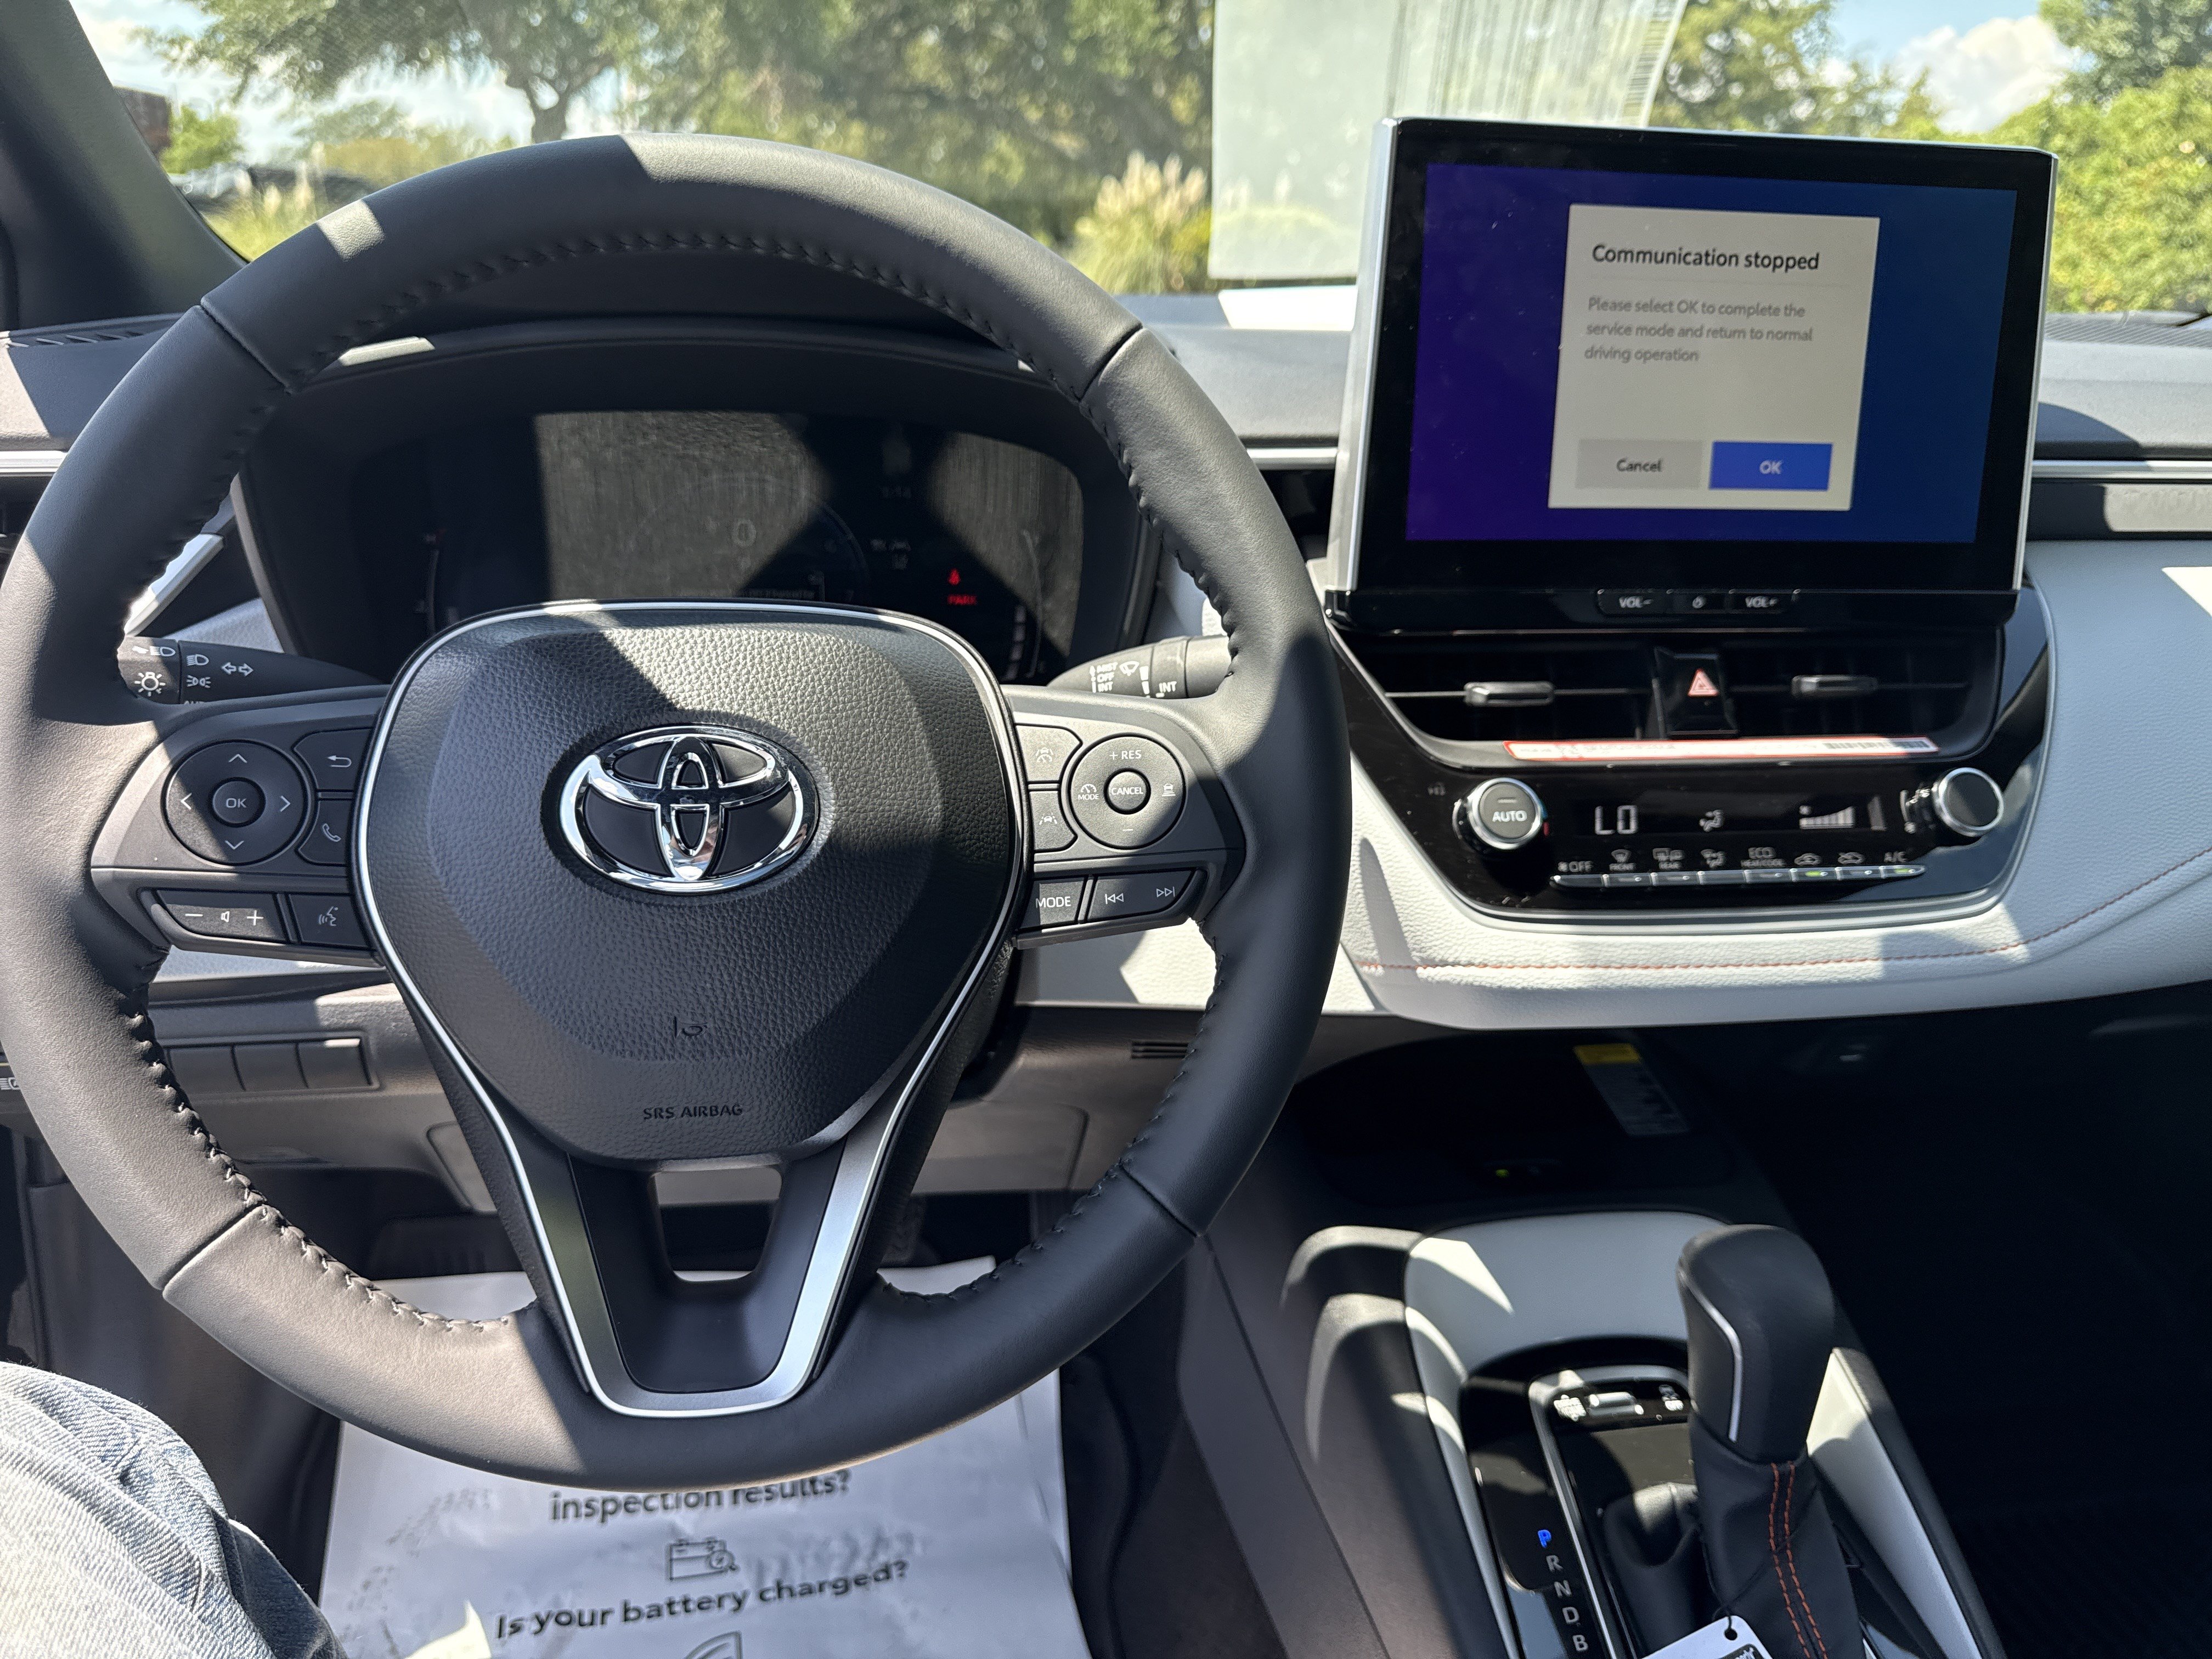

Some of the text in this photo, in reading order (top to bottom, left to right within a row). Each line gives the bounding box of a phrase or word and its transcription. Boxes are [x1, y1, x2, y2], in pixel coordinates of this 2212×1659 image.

[1592, 244, 1820, 273] Communication stopped
[1588, 297, 1805, 320] Please select OK to complete the
[1586, 323, 1813, 342] service mode and return to normal
[1584, 346, 1700, 364] driving operation
[1616, 458, 1663, 473] Cancel
[1759, 460, 1782, 475] OK
[1097, 662, 1118, 674] MIST
[1097, 672, 1114, 683] OFF
[1098, 681, 1113, 692] INT
[1159, 681, 1177, 692] INT
[1111, 786, 1144, 795] CANCEL
[225, 797, 246, 809] OK
[1492, 810, 1527, 822] AUTO
[1884, 851, 1909, 863] A/C
[1568, 860, 1593, 873] OFF
[1035, 896, 1071, 909] MODE
[644, 1103, 743, 1120] SRS AIRBAG
[550, 1469, 852, 1523] inspection results?
[1538, 1529, 1552, 1548] P
[1546, 1554, 1563, 1572] R
[1554, 1579, 1572, 1598] N
[496, 1559, 910, 1639] Is your battery charged?
[1563, 1606, 1580, 1624] D
[1573, 1634, 1589, 1652] B
